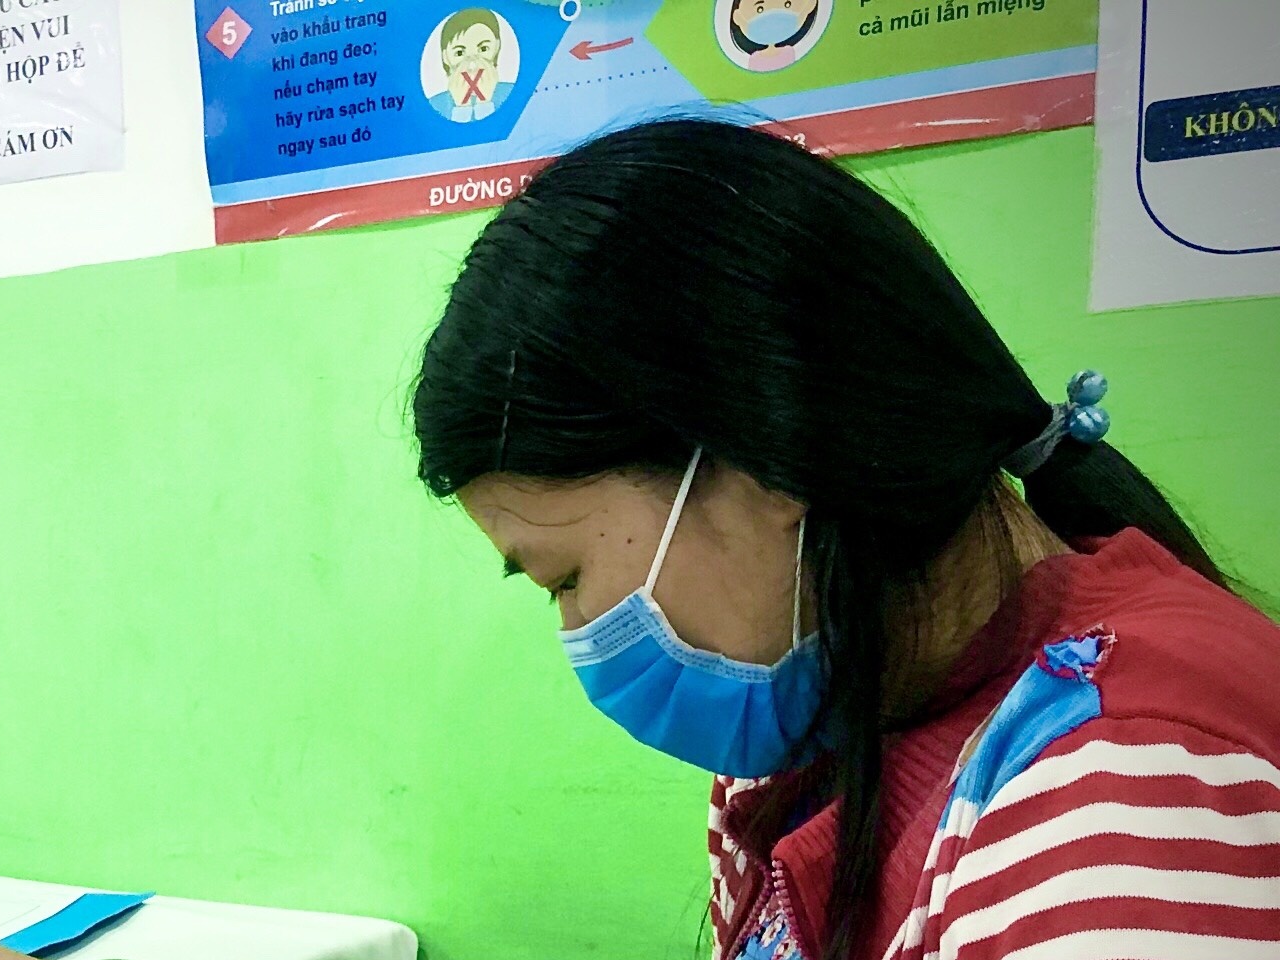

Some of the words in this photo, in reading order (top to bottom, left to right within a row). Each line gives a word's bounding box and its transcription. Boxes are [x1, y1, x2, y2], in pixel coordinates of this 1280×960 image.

[31, 14, 70, 41] VUI
[271, 27, 298, 44] vào
[303, 15, 340, 38] khẩu
[345, 11, 387, 27] trang
[859, 16, 883, 36] cả
[890, 8, 929, 31] mũi
[936, 0, 969, 22] lẫn
[222, 21, 237, 46] 5
[7, 55, 49, 84] HỘP
[56, 42, 86, 72] ĐỂ
[272, 55, 295, 72] khi
[300, 49, 338, 66] đang
[343, 42, 377, 58] đeo;
[274, 80, 302, 100] nếu
[307, 76, 349, 94] chạm
[354, 71, 377, 87] tay
[275, 111, 303, 128] hãy
[308, 105, 335, 122] rửa
[339, 97, 376, 119] sạch
[381, 95, 405, 111] tay
[42, 125, 74, 150] ƠN
[278, 139, 314, 157] ngay
[320, 133, 347, 148] sau
[352, 126, 371, 142] đó
[428, 177, 513, 206] ĐƯỜNG
